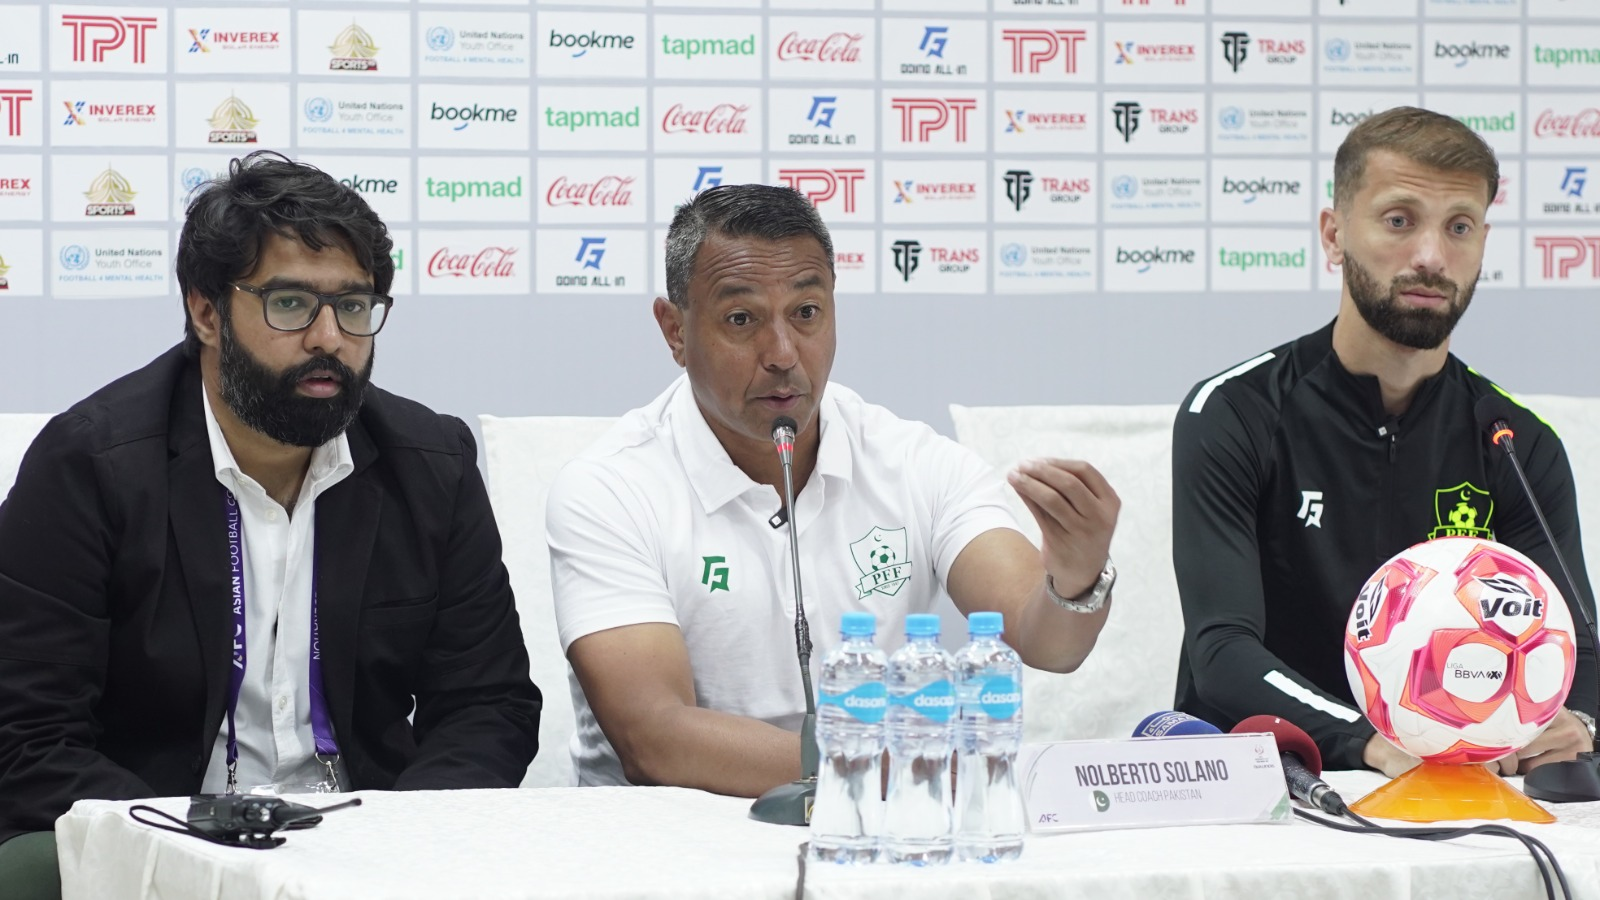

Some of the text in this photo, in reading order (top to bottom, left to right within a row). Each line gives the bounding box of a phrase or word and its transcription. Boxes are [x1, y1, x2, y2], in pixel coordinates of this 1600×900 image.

[62, 15, 157, 63] TPT
[213, 32, 280, 43] INVEREX
[460, 31, 524, 41] United Nations
[550, 30, 635, 49] bookme
[662, 34, 755, 59] tapmad
[1003, 30, 1086, 73] TPT
[1137, 44, 1195, 56] INVEREX
[1258, 39, 1306, 54] TRANS
[1435, 41, 1510, 59] bookme
[1267, 55, 1297, 64] GROUP
[89, 104, 156, 116] INVEREX
[338, 102, 403, 111] United Nations
[431, 103, 517, 122] bookme
[545, 106, 640, 132] tapmad
[892, 98, 976, 142] TPT
[1028, 113, 1086, 124] INVEREX
[1150, 109, 1198, 123] TRANS
[1160, 124, 1189, 133] GROUP
[341, 174, 398, 193] okme
[426, 176, 522, 202] tapmad
[916, 183, 976, 194] INVEREX
[1041, 177, 1090, 193] TRANS
[1223, 176, 1300, 194] bookme
[1051, 194, 1081, 203] GROUP
[86, 204, 124, 215] SPORTS
[95, 248, 162, 257] United Nations
[930, 248, 979, 262] TRANS
[1117, 246, 1195, 264] bookme
[1220, 247, 1305, 271] tapmad
[95, 259, 152, 269] Youth Office
[939, 264, 970, 273] GROUP
[227, 509, 240, 572] FOOTBALL
[871, 566, 902, 585] PFF
[232, 577, 242, 615] ASIAN
[1356, 584, 1371, 641] Voit
[1481, 598, 1542, 619] Voit
[1454, 669, 1486, 679] BBVA
[1075, 762, 1161, 787] NOLBERTO
[1166, 759, 1229, 783] SOLANO
[1114, 788, 1203, 804] HEAD COACH PAKISTAN
[1039, 813, 1059, 823] AFC
